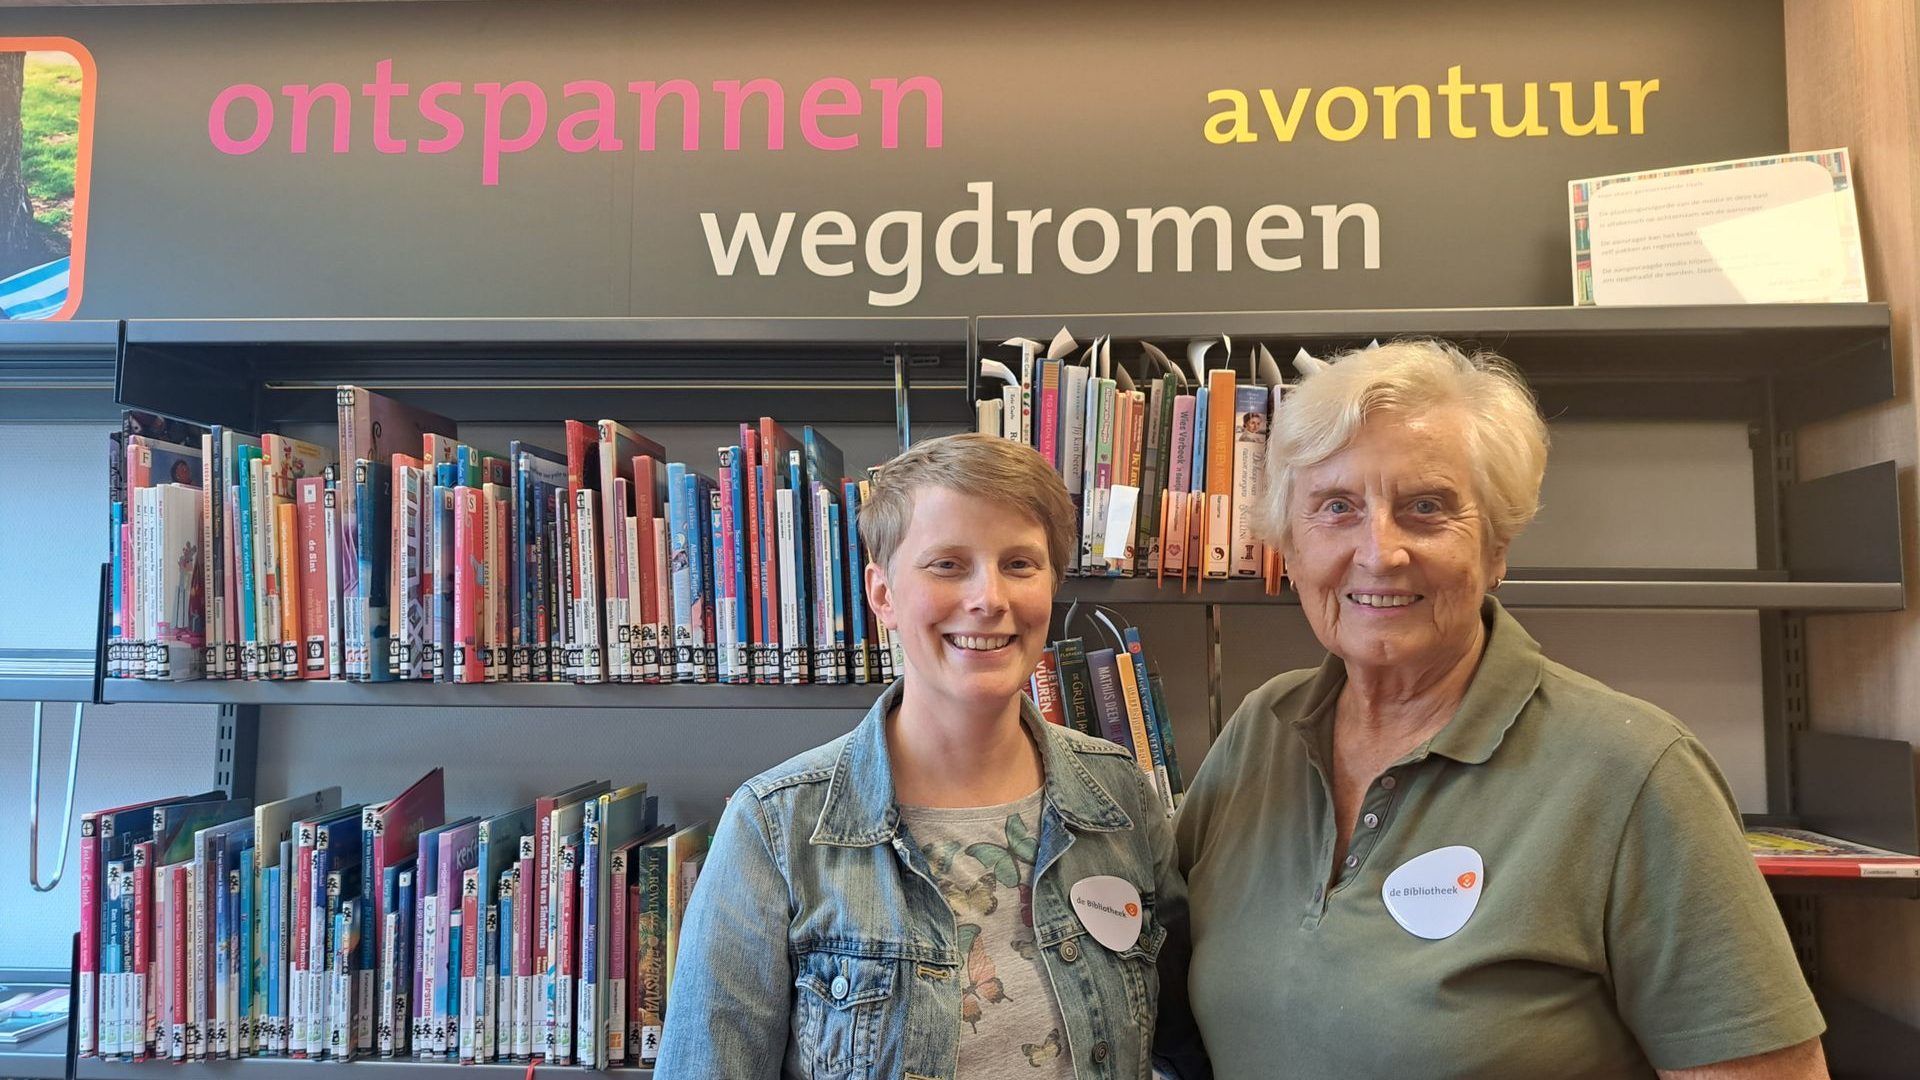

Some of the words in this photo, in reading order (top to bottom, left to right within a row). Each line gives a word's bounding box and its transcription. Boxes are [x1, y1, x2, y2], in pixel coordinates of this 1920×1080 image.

[1203, 65, 1660, 144] avontuur
[208, 59, 943, 186] ontspannen
[700, 181, 1382, 307] wegdromen
[1181, 411, 1189, 431] Wies
[1073, 437, 1082, 452] kan
[1177, 432, 1187, 464] Verbeek
[309, 540, 317, 551] de
[309, 552, 318, 573] Sint
[1036, 660, 1053, 714] VUUREN
[1047, 669, 1058, 688] JET
[1098, 666, 1115, 701] MATHIJS
[1071, 681, 1086, 717] GRIJZE
[1104, 702, 1120, 724] DEEN
[1148, 731, 1161, 766] VERJAA
[541, 835, 549, 868] Geheime
[649, 856, 660, 874] J.K.
[541, 869, 549, 888] Boek
[1389, 888, 1401, 897] de
[1403, 886, 1458, 896] Bibliotheek
[540, 889, 548, 904] van
[1076, 897, 1086, 905] de
[1087, 900, 1127, 918] Bibliotheek
[465, 925, 474, 943] HAPPY
[540, 905, 548, 948] Sinterklaas
[124, 931, 132, 955] boven
[300, 927, 308, 969] winterknuts
[424, 977, 433, 1017] Kerstmis
[643, 956, 662, 1012] KERSTVA
